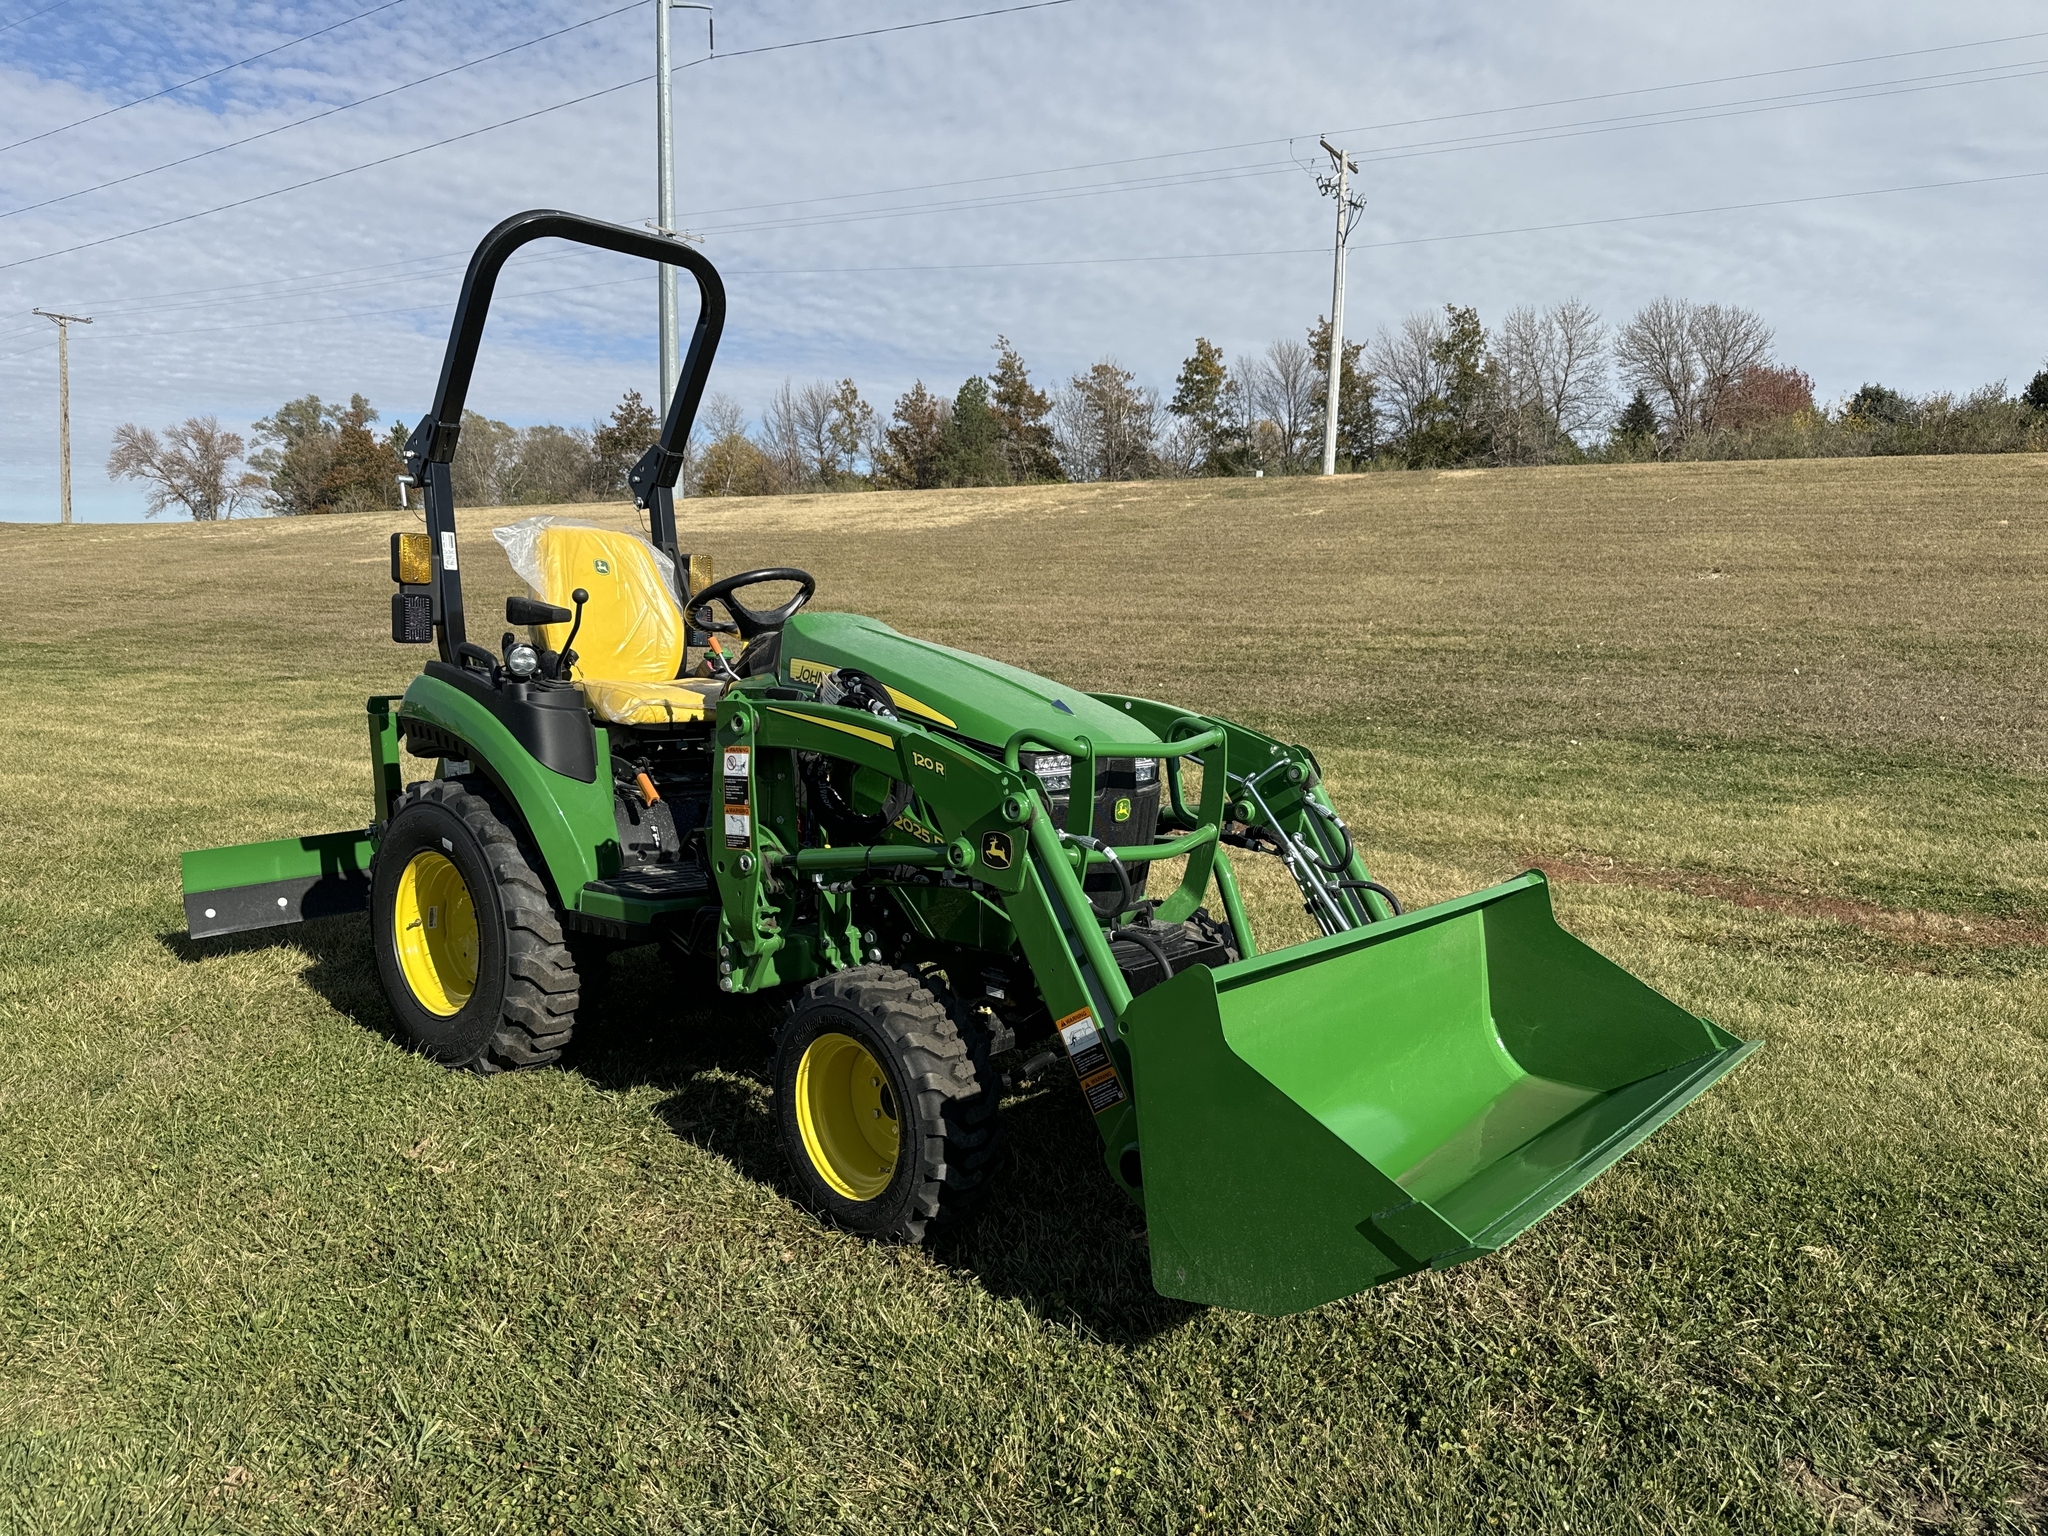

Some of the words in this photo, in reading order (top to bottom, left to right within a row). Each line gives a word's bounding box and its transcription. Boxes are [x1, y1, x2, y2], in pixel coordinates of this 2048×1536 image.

[912, 751, 934, 770] 120
[935, 761, 945, 776] R
[893, 815, 931, 844] 2025
[1066, 1011, 1087, 1025] WARNING
[1090, 1071, 1112, 1084] WARNING
